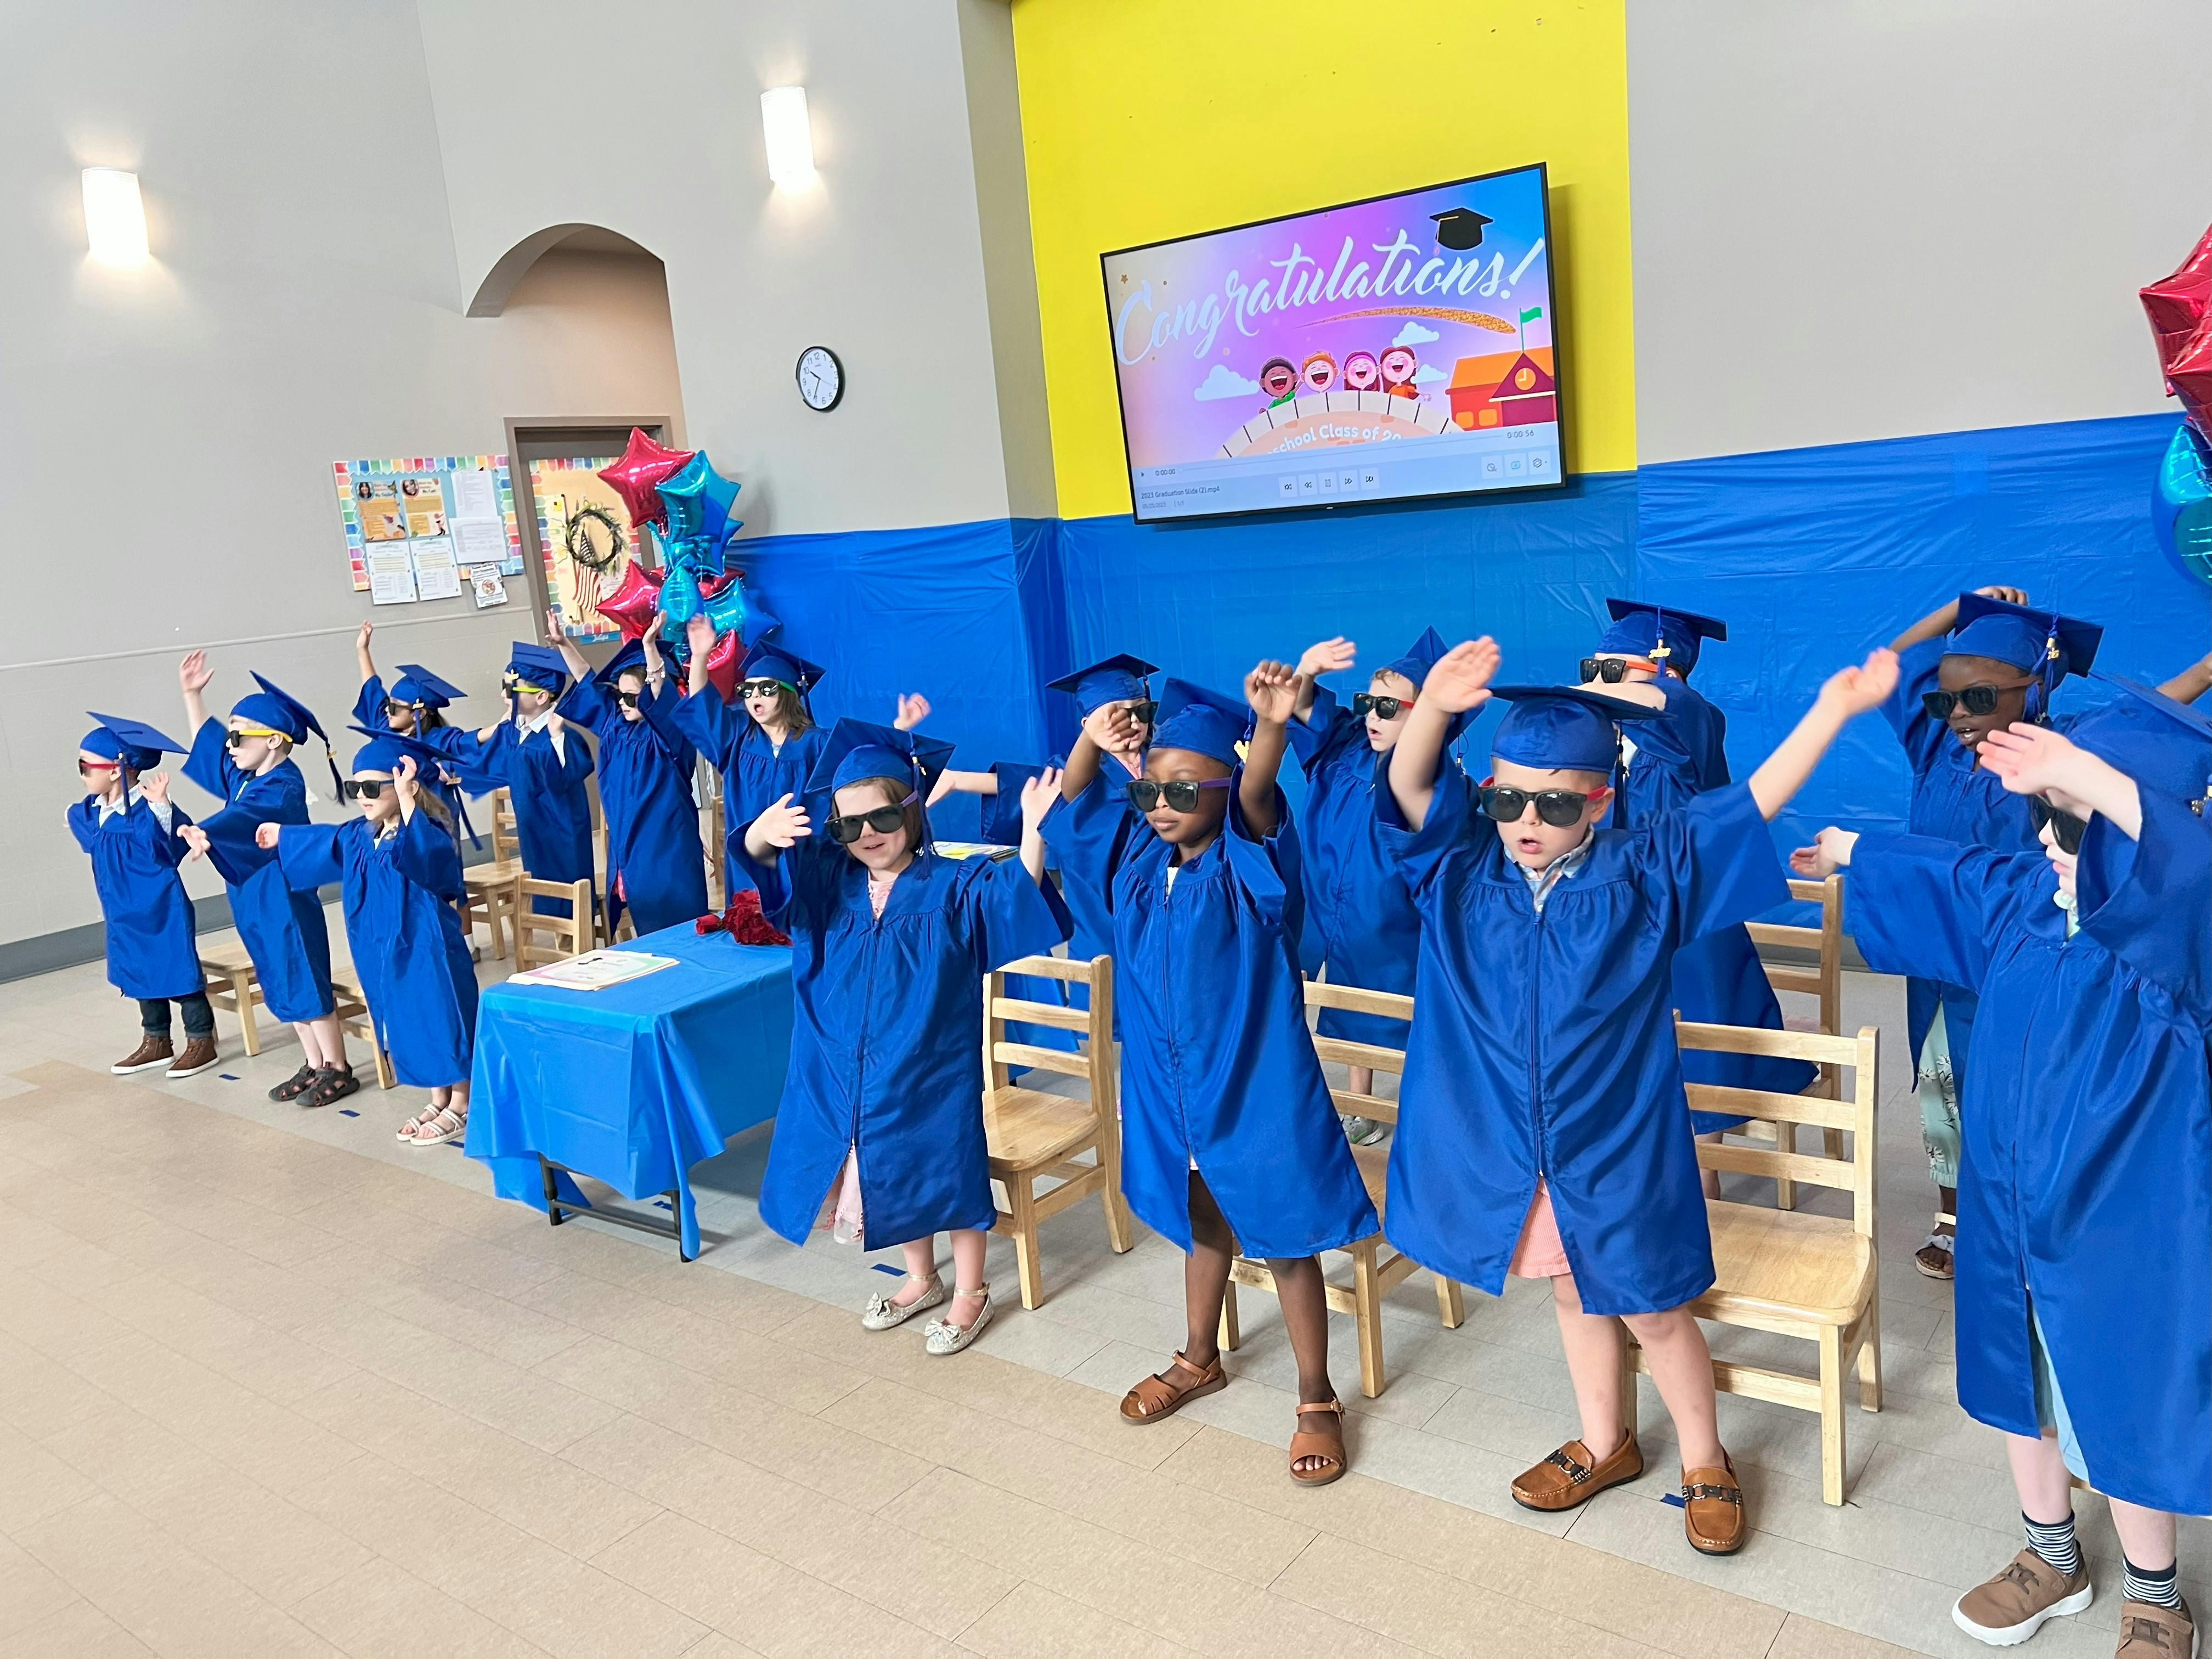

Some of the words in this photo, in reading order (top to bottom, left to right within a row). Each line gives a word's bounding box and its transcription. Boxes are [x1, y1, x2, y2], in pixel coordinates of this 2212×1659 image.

[1116, 228, 1544, 365] Congratulations!
[814, 352, 820, 360] 12
[829, 360, 834, 368] 2
[802, 378, 807, 386] 9
[807, 389, 812, 397] 8
[828, 392, 833, 400] 5
[821, 397, 826, 405] 6
[1267, 426, 1317, 454] school
[1319, 423, 1359, 439] Class
[1362, 426, 1379, 441] of
[1506, 430, 1534, 439] 0:00:56
[1155, 489, 1184, 498] Graduation
[1199, 486, 1220, 494] (2).mp4
